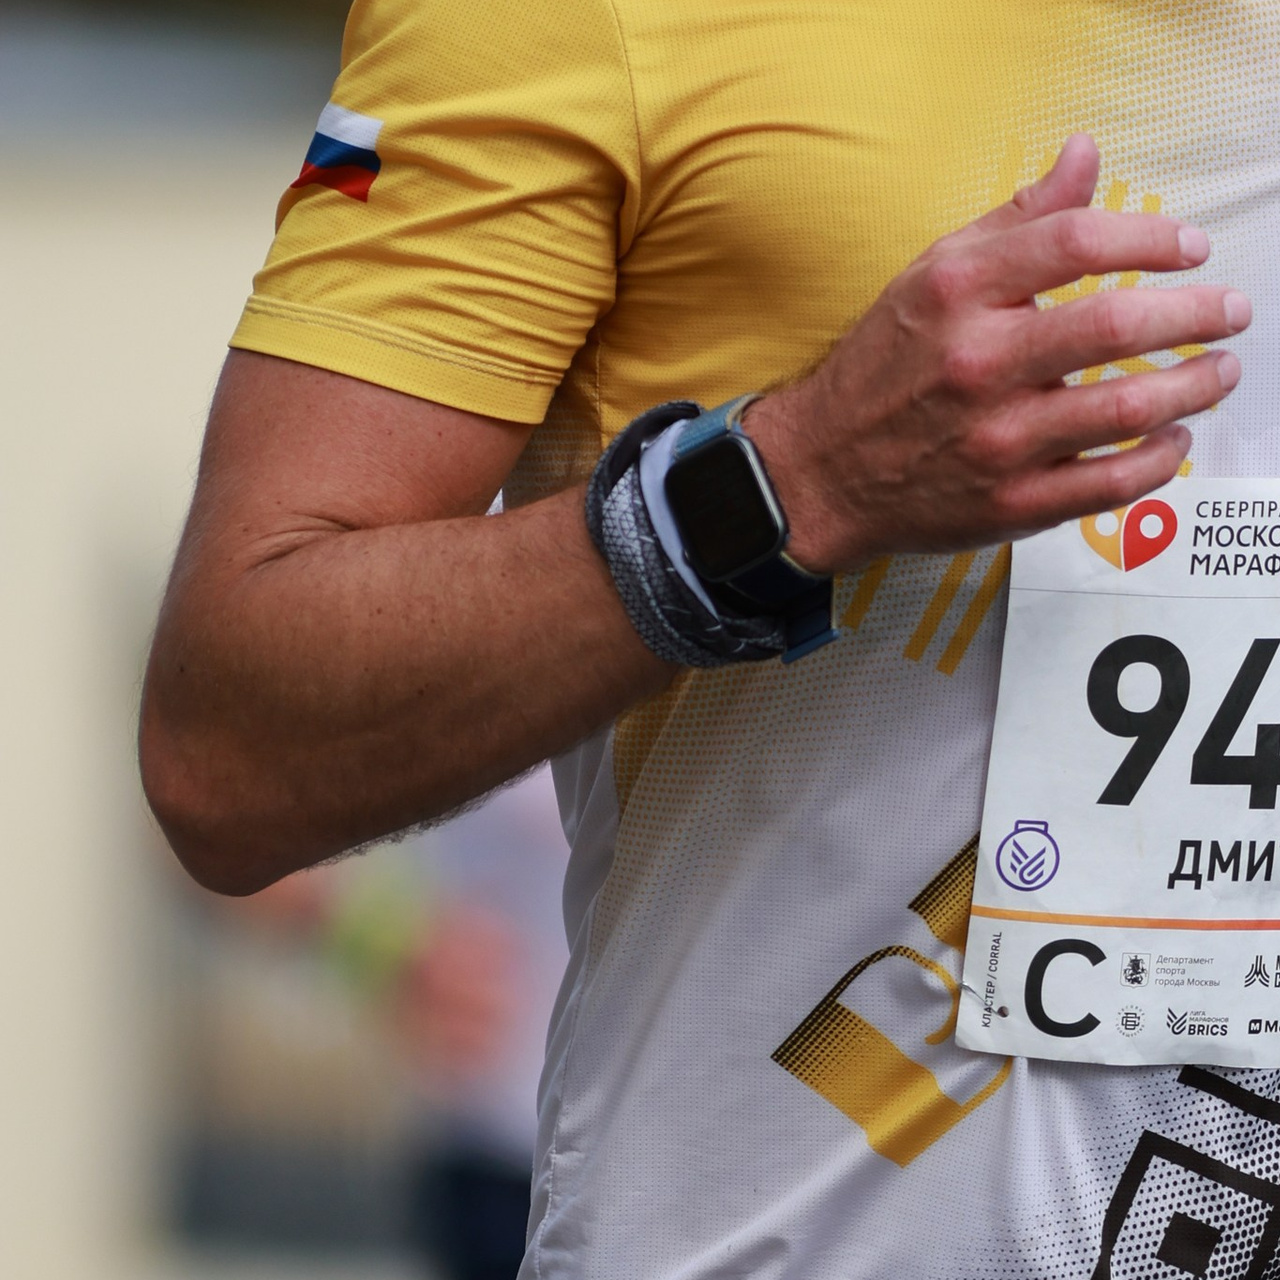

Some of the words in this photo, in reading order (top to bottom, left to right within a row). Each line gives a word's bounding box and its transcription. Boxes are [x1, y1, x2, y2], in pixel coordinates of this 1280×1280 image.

[1156, 955, 1215, 966] Департамент
[1156, 967, 1186, 977] спорта
[981, 980, 996, 1028] КЛАСТЕР
[990, 932, 1002, 973] CORRAL
[1155, 977, 1185, 988] города
[1187, 978, 1220, 987] Москвы
[1187, 1024, 1228, 1036] BRICS
